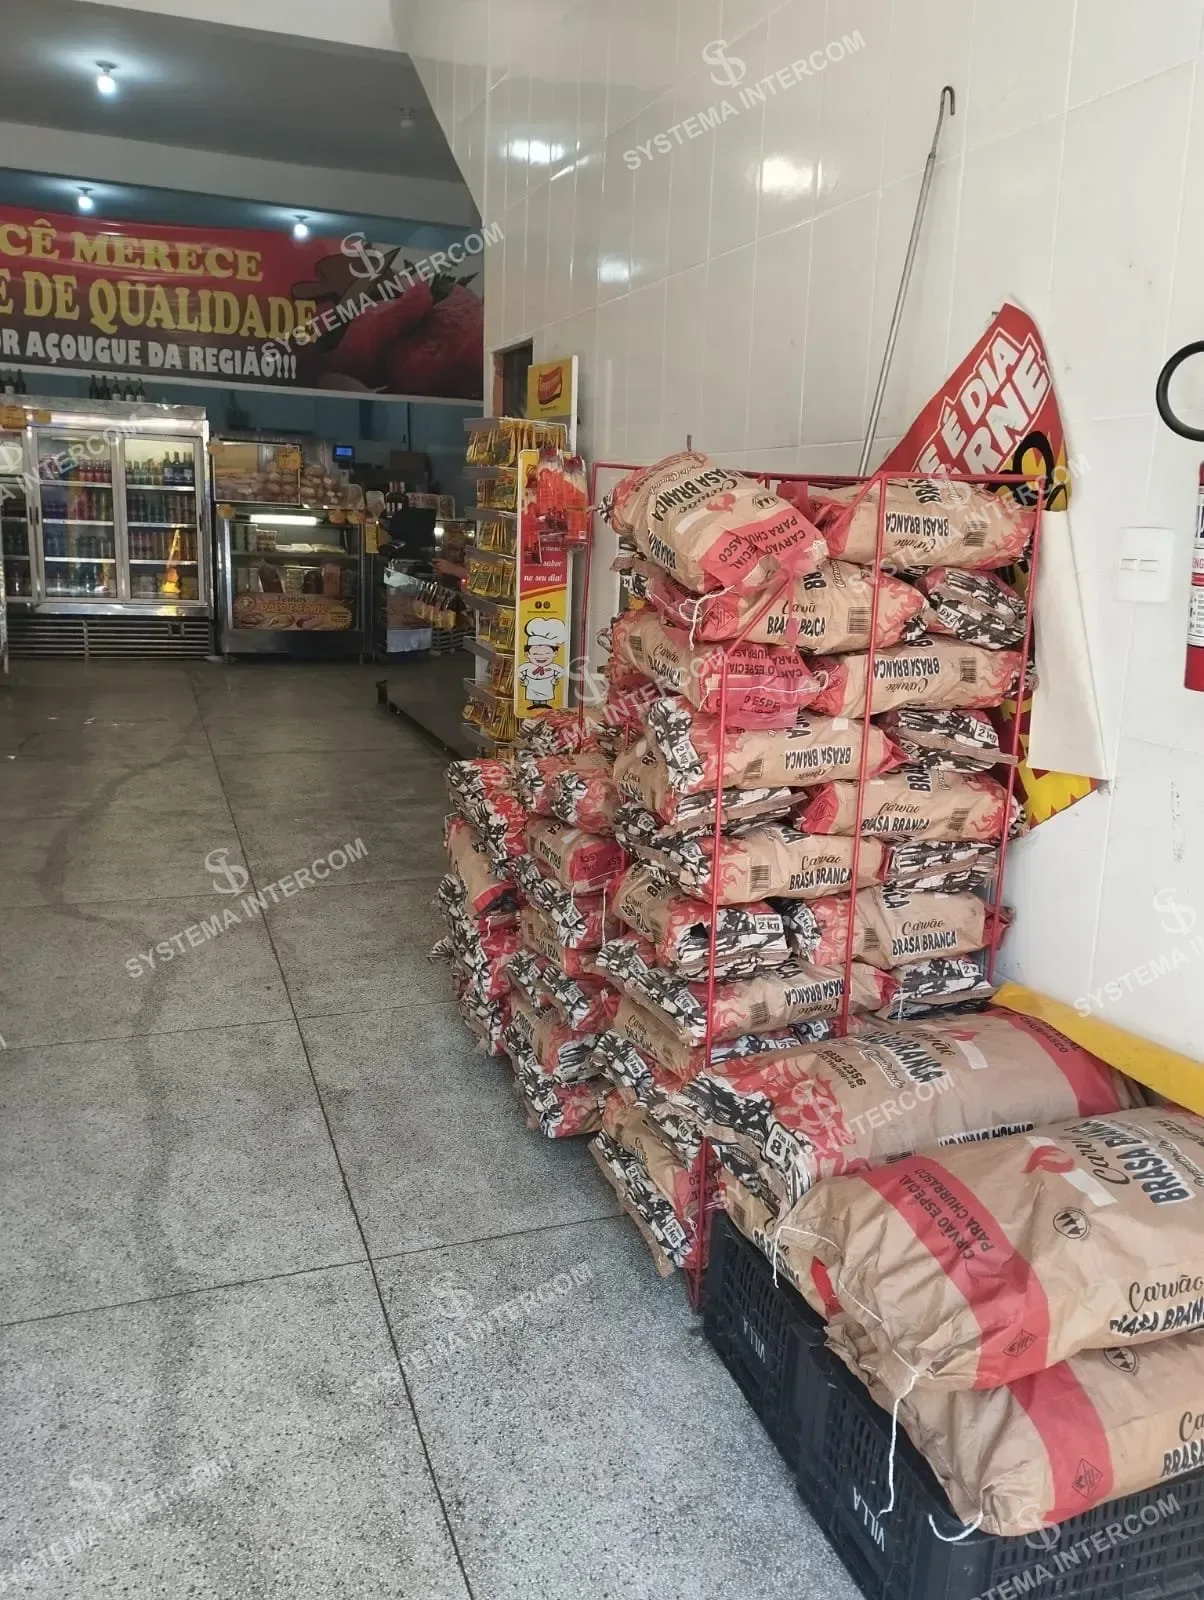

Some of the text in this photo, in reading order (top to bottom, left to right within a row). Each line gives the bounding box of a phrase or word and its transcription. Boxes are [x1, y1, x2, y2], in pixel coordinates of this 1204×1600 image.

[71, 232, 264, 282] MERECE
[23, 271, 80, 320] DE
[89, 279, 319, 344] QUALIDADE
[0, 328, 297, 380] R AÇOUGUE DA REGIÃO!!!
[960, 336, 1021, 426] DIA
[948, 345, 1049, 475] RNE
[651, 480, 702, 522] BRANCA
[718, 515, 799, 563] PARA CHURASCO
[764, 529, 806, 556] CARVÃO
[885, 512, 950, 537] BRASA BRANCA
[909, 656, 940, 676] BRASA
[785, 746, 852, 770] BRASA BRANCA
[891, 817, 930, 832] BRANCA
[788, 867, 854, 891] BRASA BRANCA
[801, 854, 842, 871] Carvão
[767, 921, 780, 931] kg
[892, 931, 958, 956] BRASA BRANCA
[901, 918, 945, 936] Carvão
[784, 982, 822, 1007] BRANCA
[1115, 1146, 1190, 1204] BRASA
[900, 1174, 943, 1219] ESPECIAL
[914, 1168, 995, 1253] PARA CHURRASCO
[1129, 1274, 1204, 1313] Carvão
[1160, 1295, 1204, 1332] BRAN
[852, 1486, 886, 1553] VILLA
